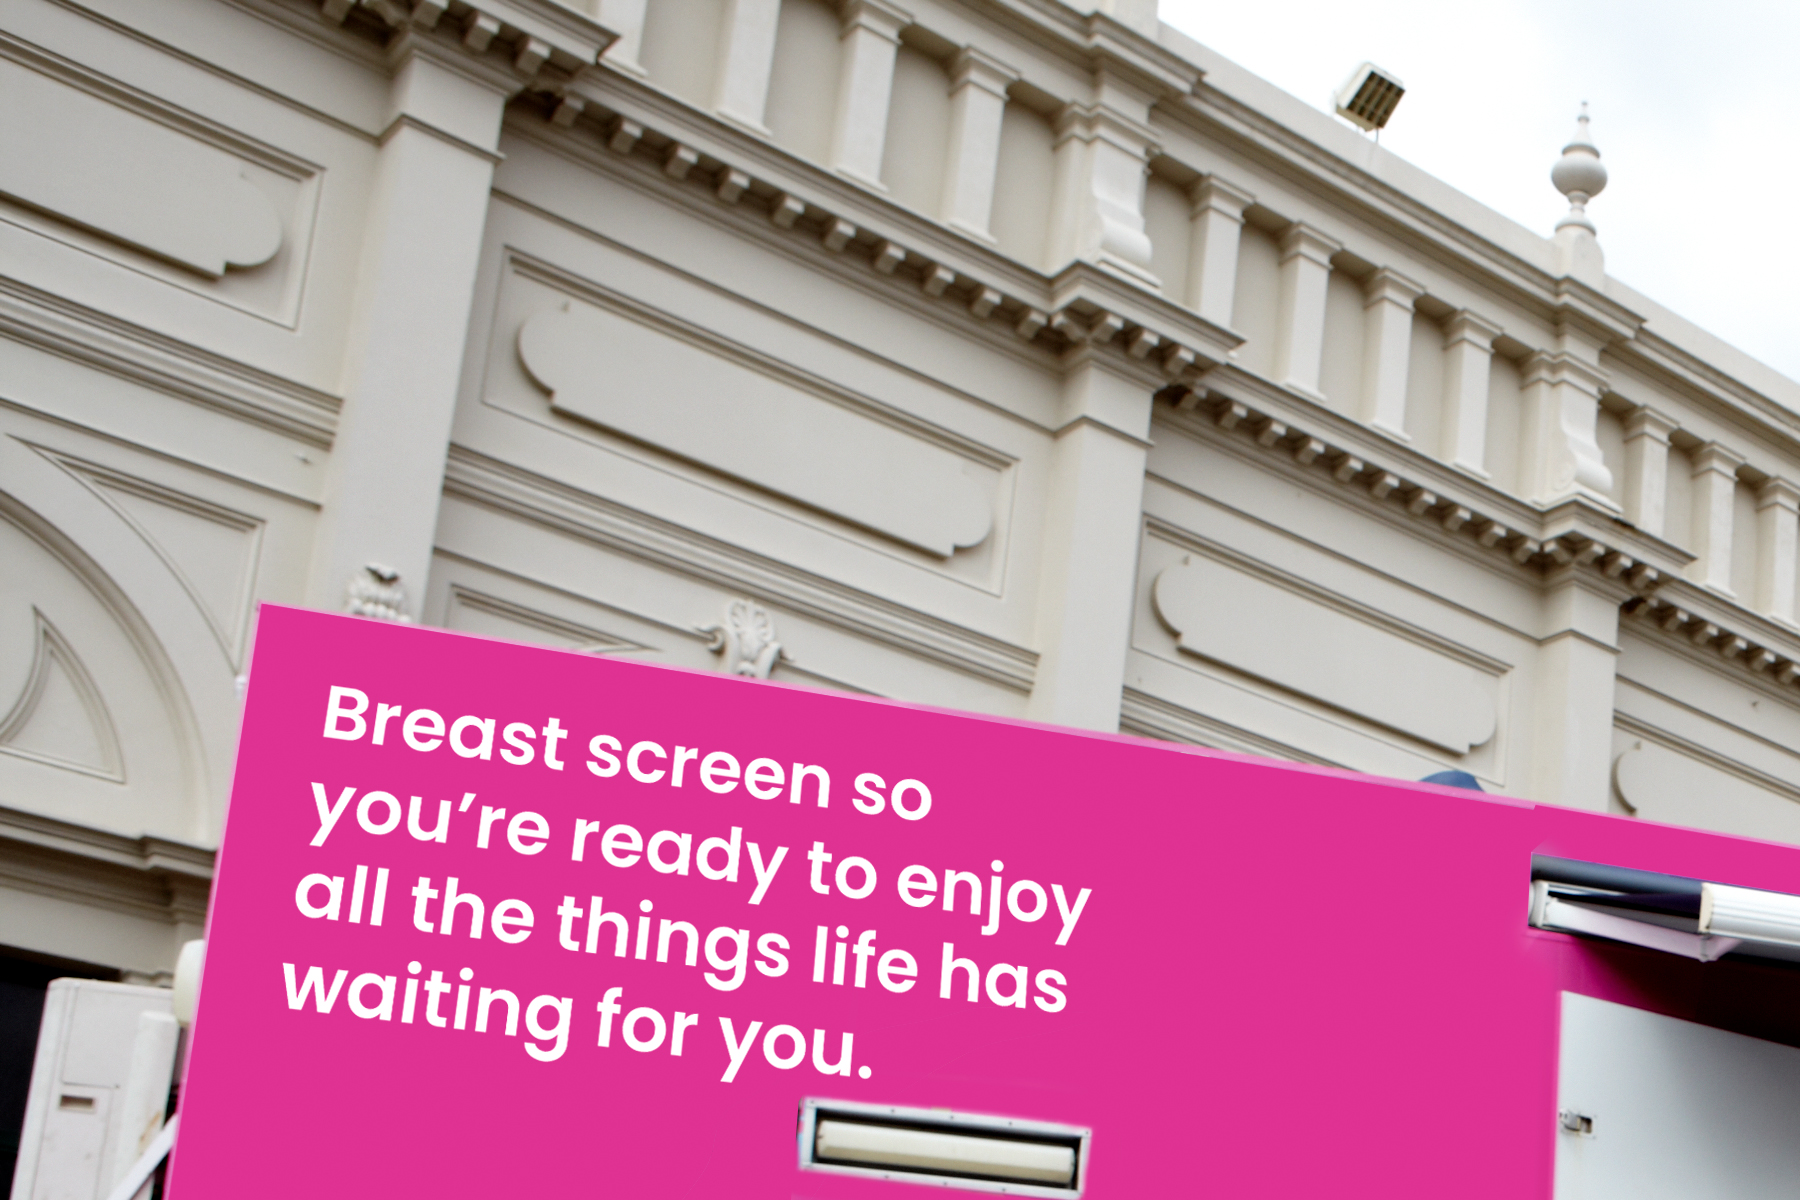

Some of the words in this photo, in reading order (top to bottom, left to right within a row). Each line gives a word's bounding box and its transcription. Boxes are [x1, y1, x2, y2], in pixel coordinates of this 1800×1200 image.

[323, 685, 568, 770] Breast
[586, 735, 830, 808] screen
[852, 773, 932, 820] so
[310, 782, 549, 855] you’re
[572, 818, 789, 905] ready
[808, 841, 877, 899] to
[898, 860, 1092, 946] enjoy
[295, 865, 389, 926] all
[412, 877, 534, 943] the
[557, 896, 790, 991] things
[813, 925, 918, 993] life
[940, 942, 1067, 1012] has
[283, 961, 573, 1062] waiting
[597, 987, 698, 1056] for
[719, 1017, 871, 1083] you.
